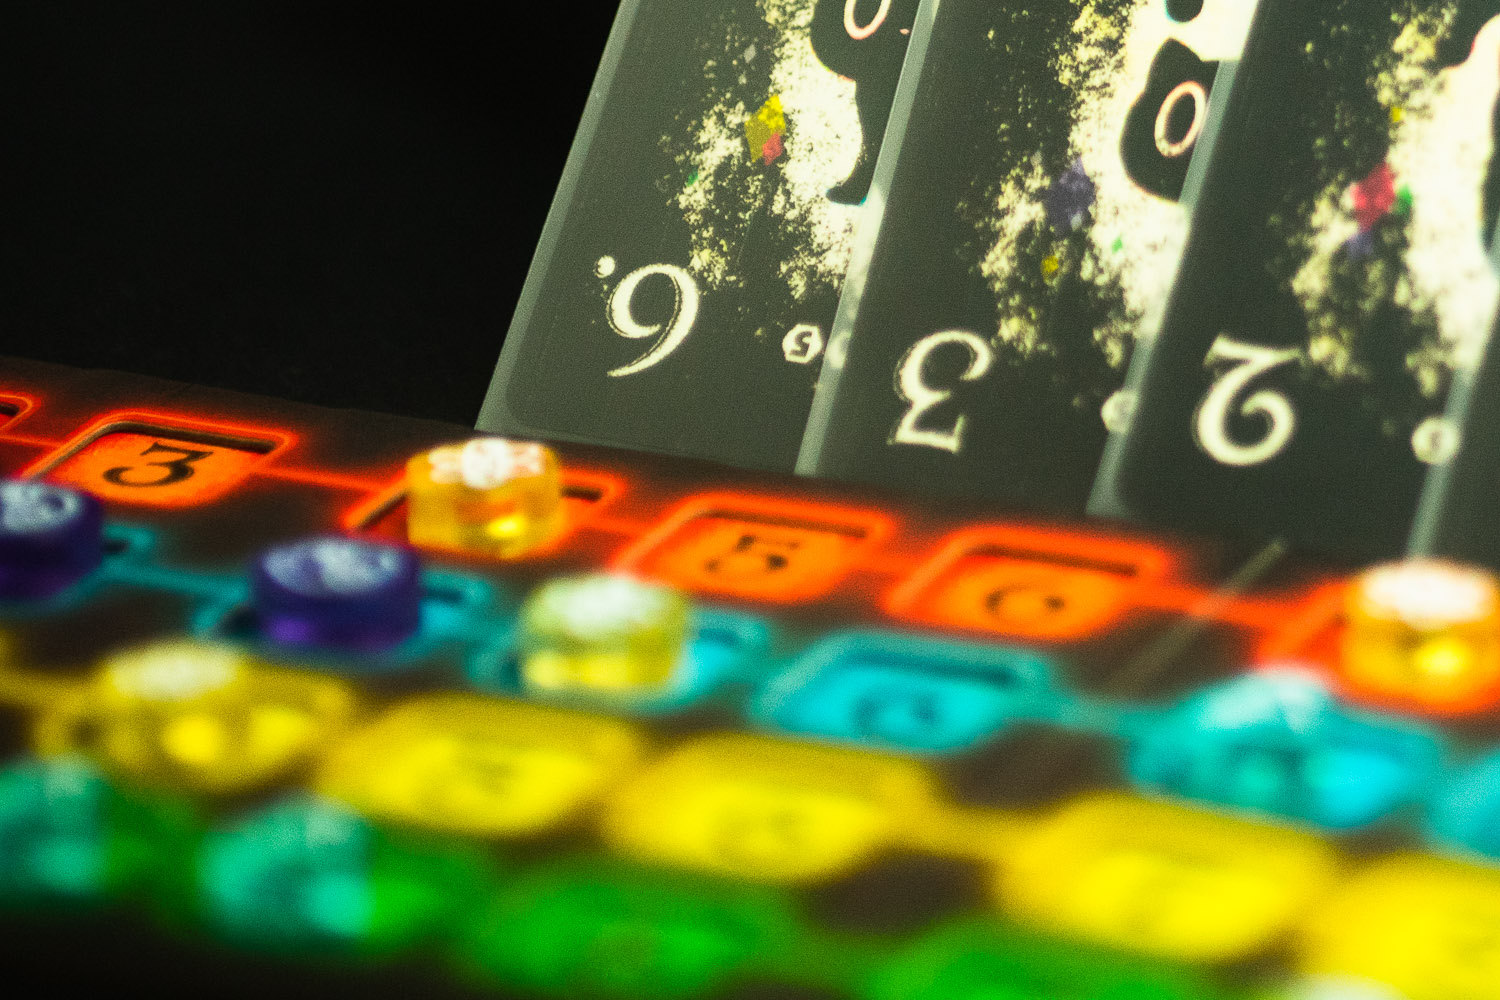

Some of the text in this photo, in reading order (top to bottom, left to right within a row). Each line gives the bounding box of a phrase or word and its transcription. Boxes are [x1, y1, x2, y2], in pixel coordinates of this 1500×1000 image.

[893, 329, 996, 454] 3
[1194, 335, 1302, 466] 2
[103, 440, 213, 488] 3
